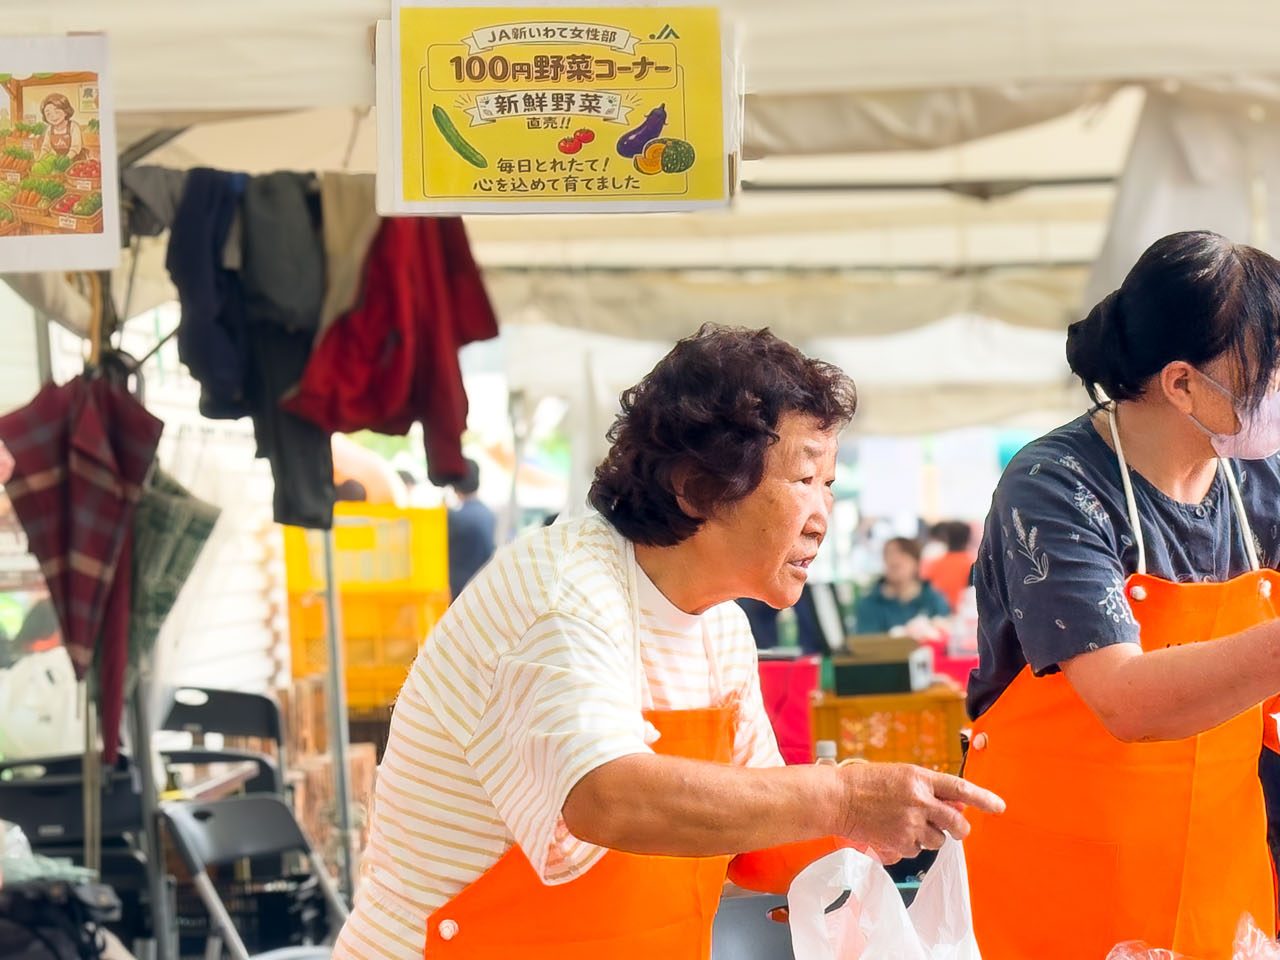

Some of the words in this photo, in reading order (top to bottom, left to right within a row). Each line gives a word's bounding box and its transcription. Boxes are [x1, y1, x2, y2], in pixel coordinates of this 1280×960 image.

[488, 27, 617, 43] JA新いわて女性部
[450, 54, 671, 81] 100円野菜コーナー
[494, 92, 604, 114] 新鮮野菜
[497, 157, 610, 174] 毎日とれたて!
[473, 174, 640, 192] 心を込めて育てました
